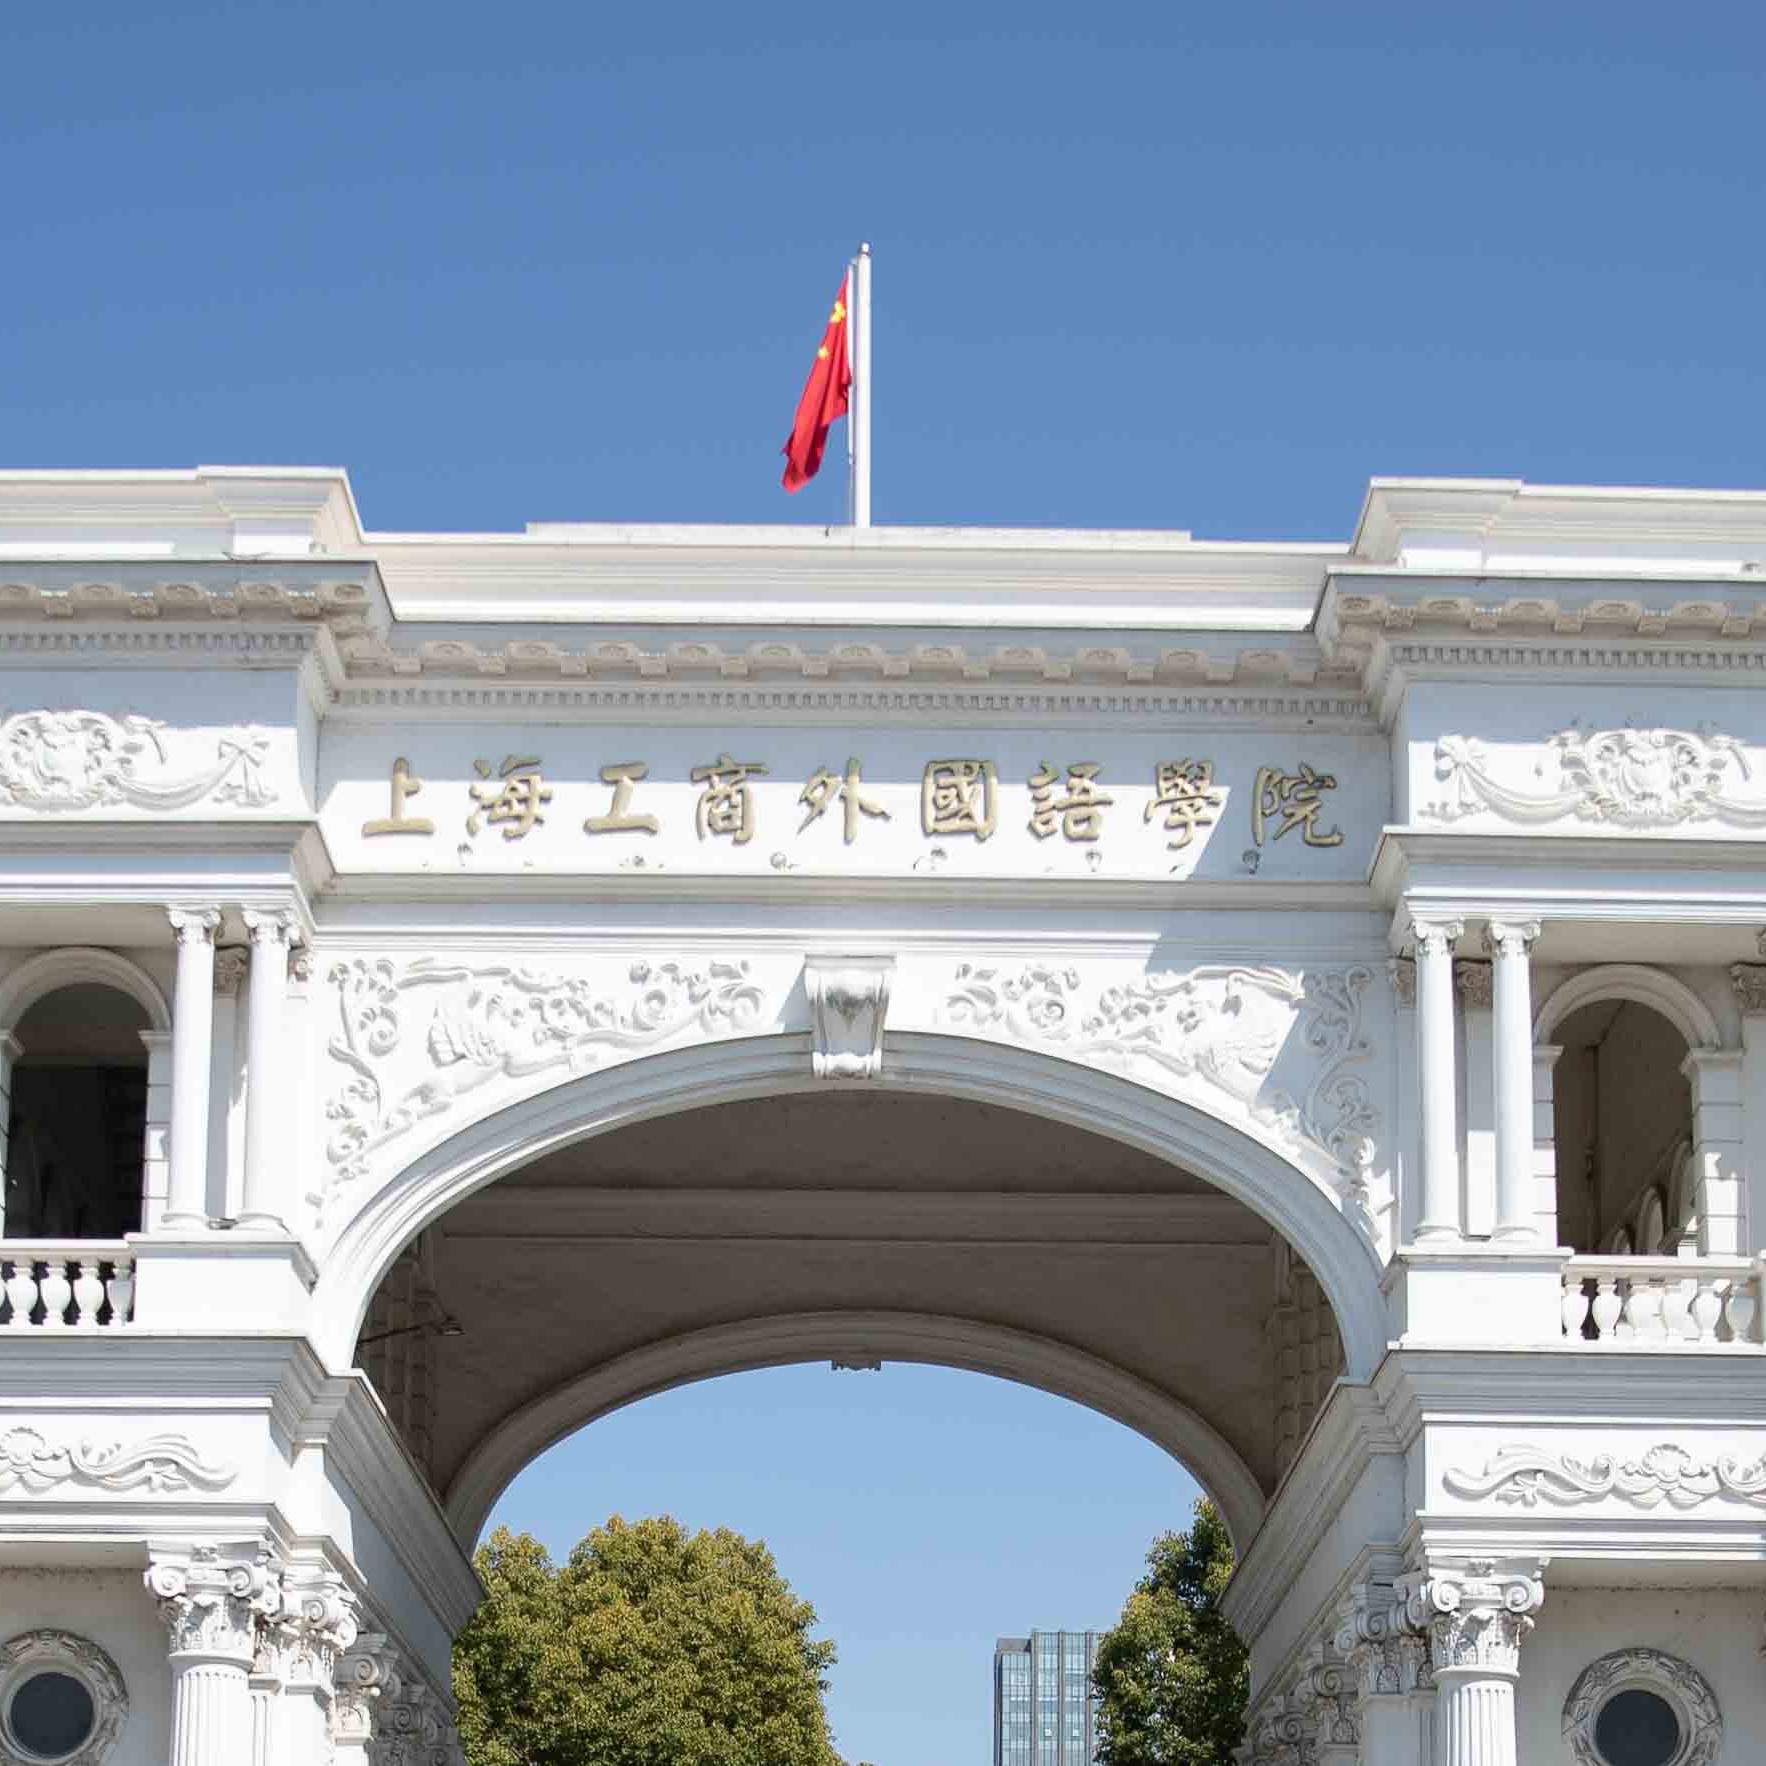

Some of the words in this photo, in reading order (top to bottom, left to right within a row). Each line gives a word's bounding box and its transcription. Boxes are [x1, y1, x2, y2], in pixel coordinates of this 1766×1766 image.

[360, 754, 1346, 849] 上海工商外國語學院
